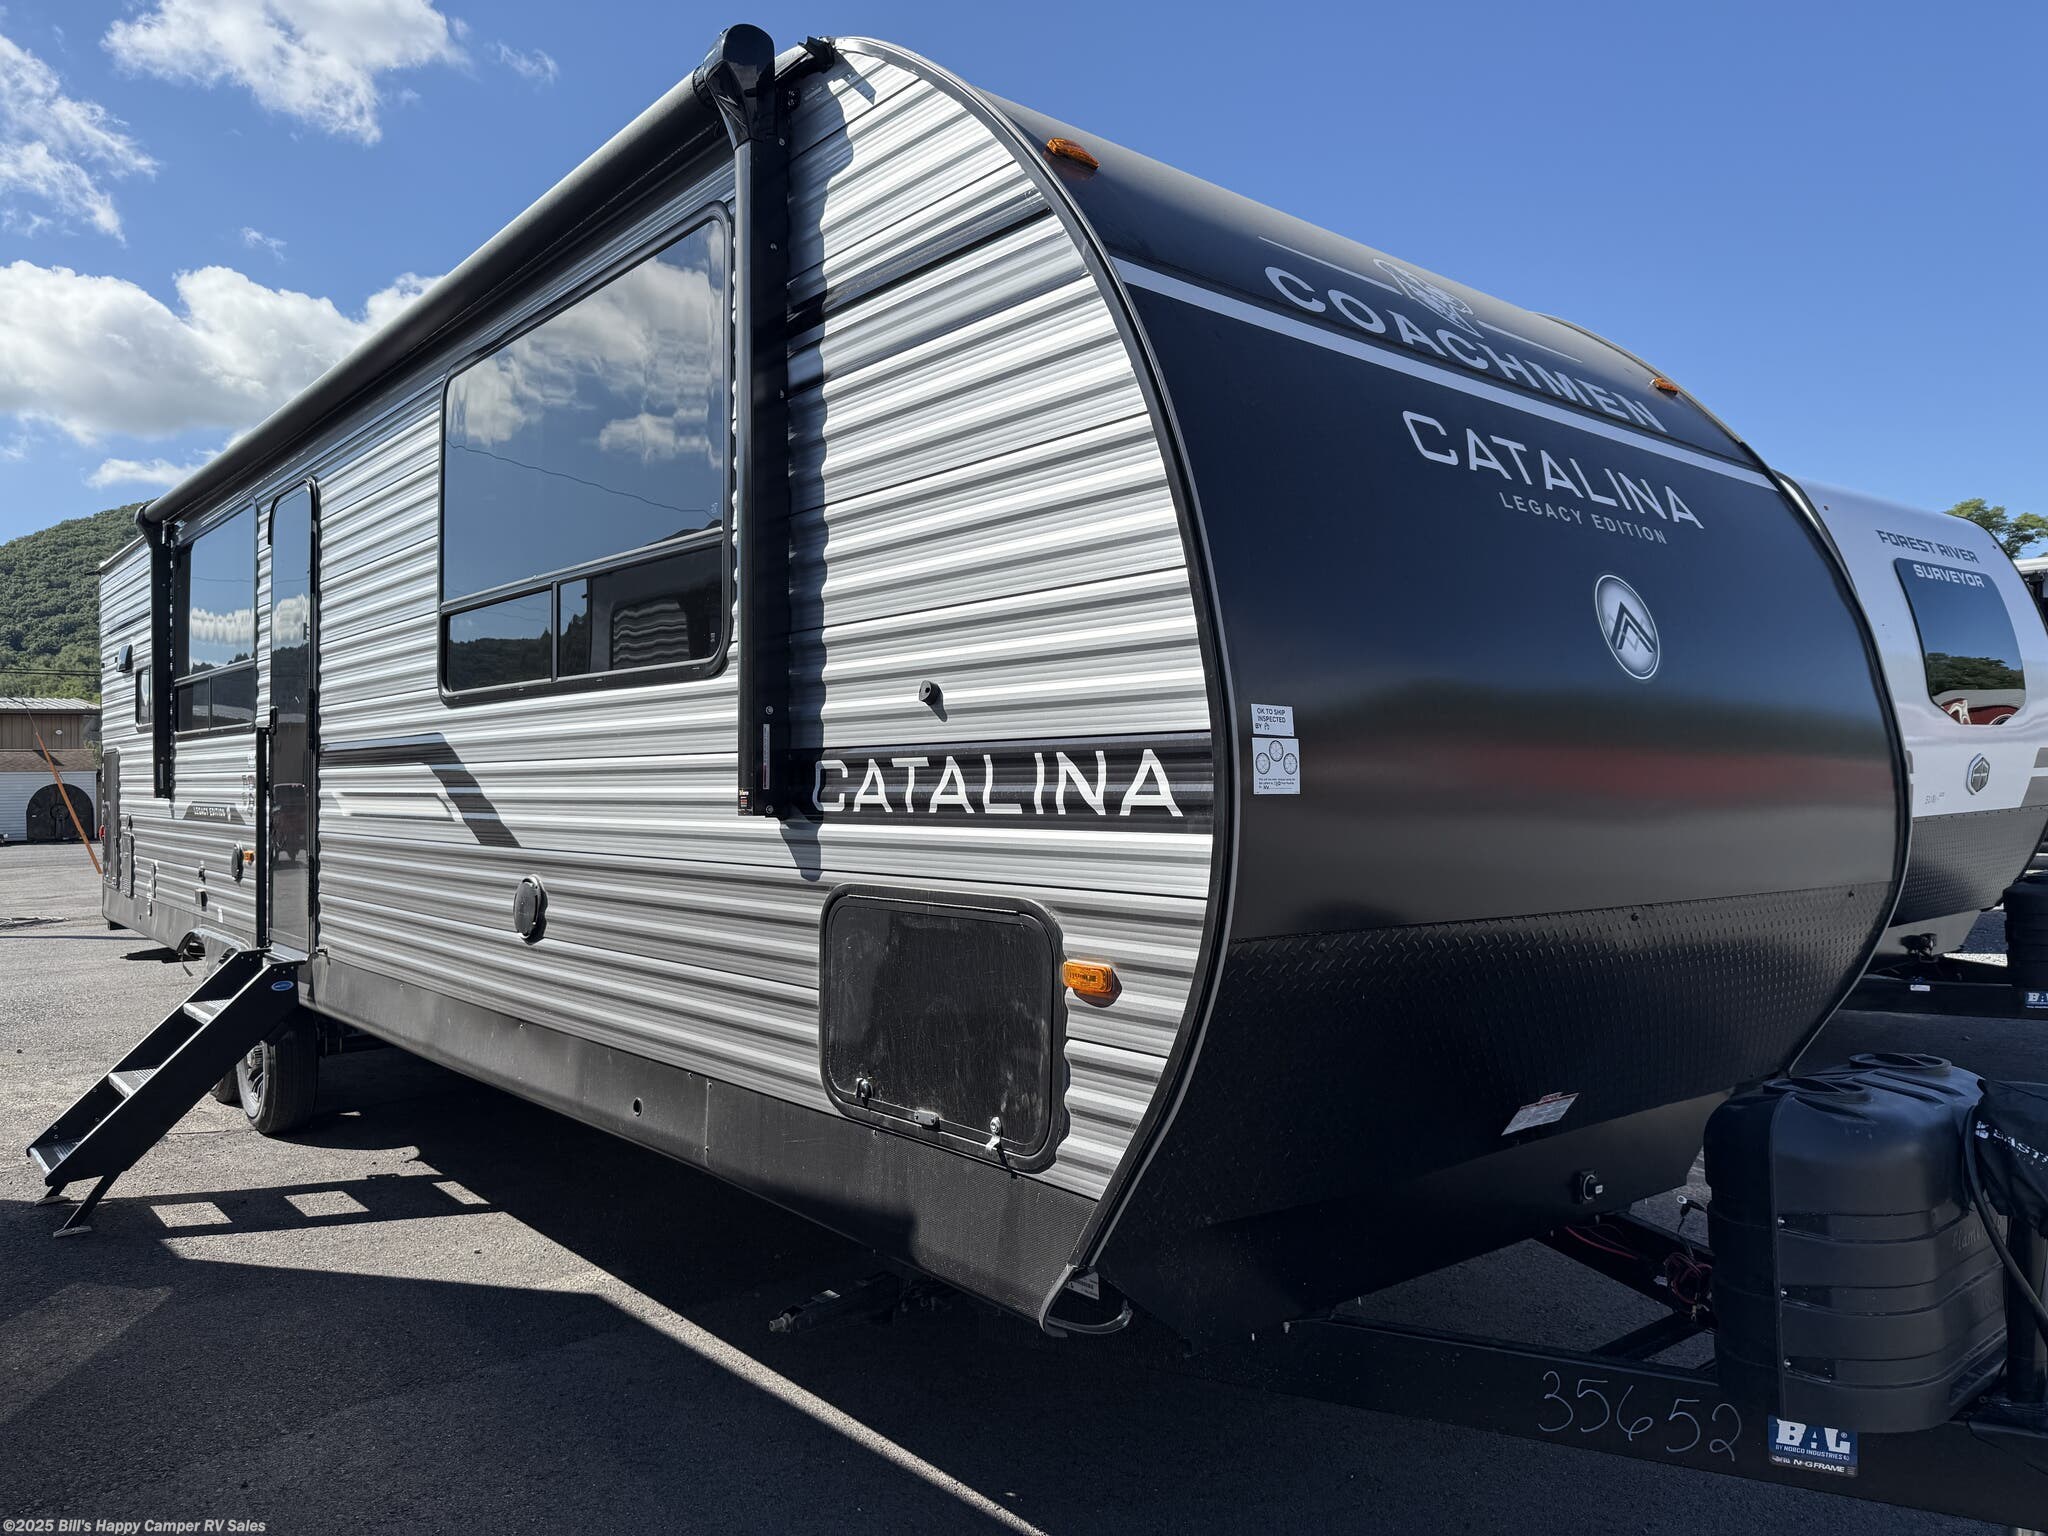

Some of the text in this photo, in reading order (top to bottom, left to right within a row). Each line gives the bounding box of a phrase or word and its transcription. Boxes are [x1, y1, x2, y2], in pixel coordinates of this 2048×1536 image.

[1264, 266, 1668, 433] COACHMEN
[1402, 410, 1704, 530] CATALINA
[1499, 491, 1668, 545] LEGACY EDITION
[1875, 529, 1980, 564] FOREST RIVER
[1912, 563, 1985, 588] SURVEYOR
[1257, 715, 1287, 724] INSPECTED
[812, 748, 1184, 818] CATALINA
[1538, 1370, 1742, 1462] 35652
[1776, 1418, 1851, 1454] BAL
[1806, 1448, 1843, 1460] INDUSTRIES
[1813, 1461, 1845, 1473] FRAME
